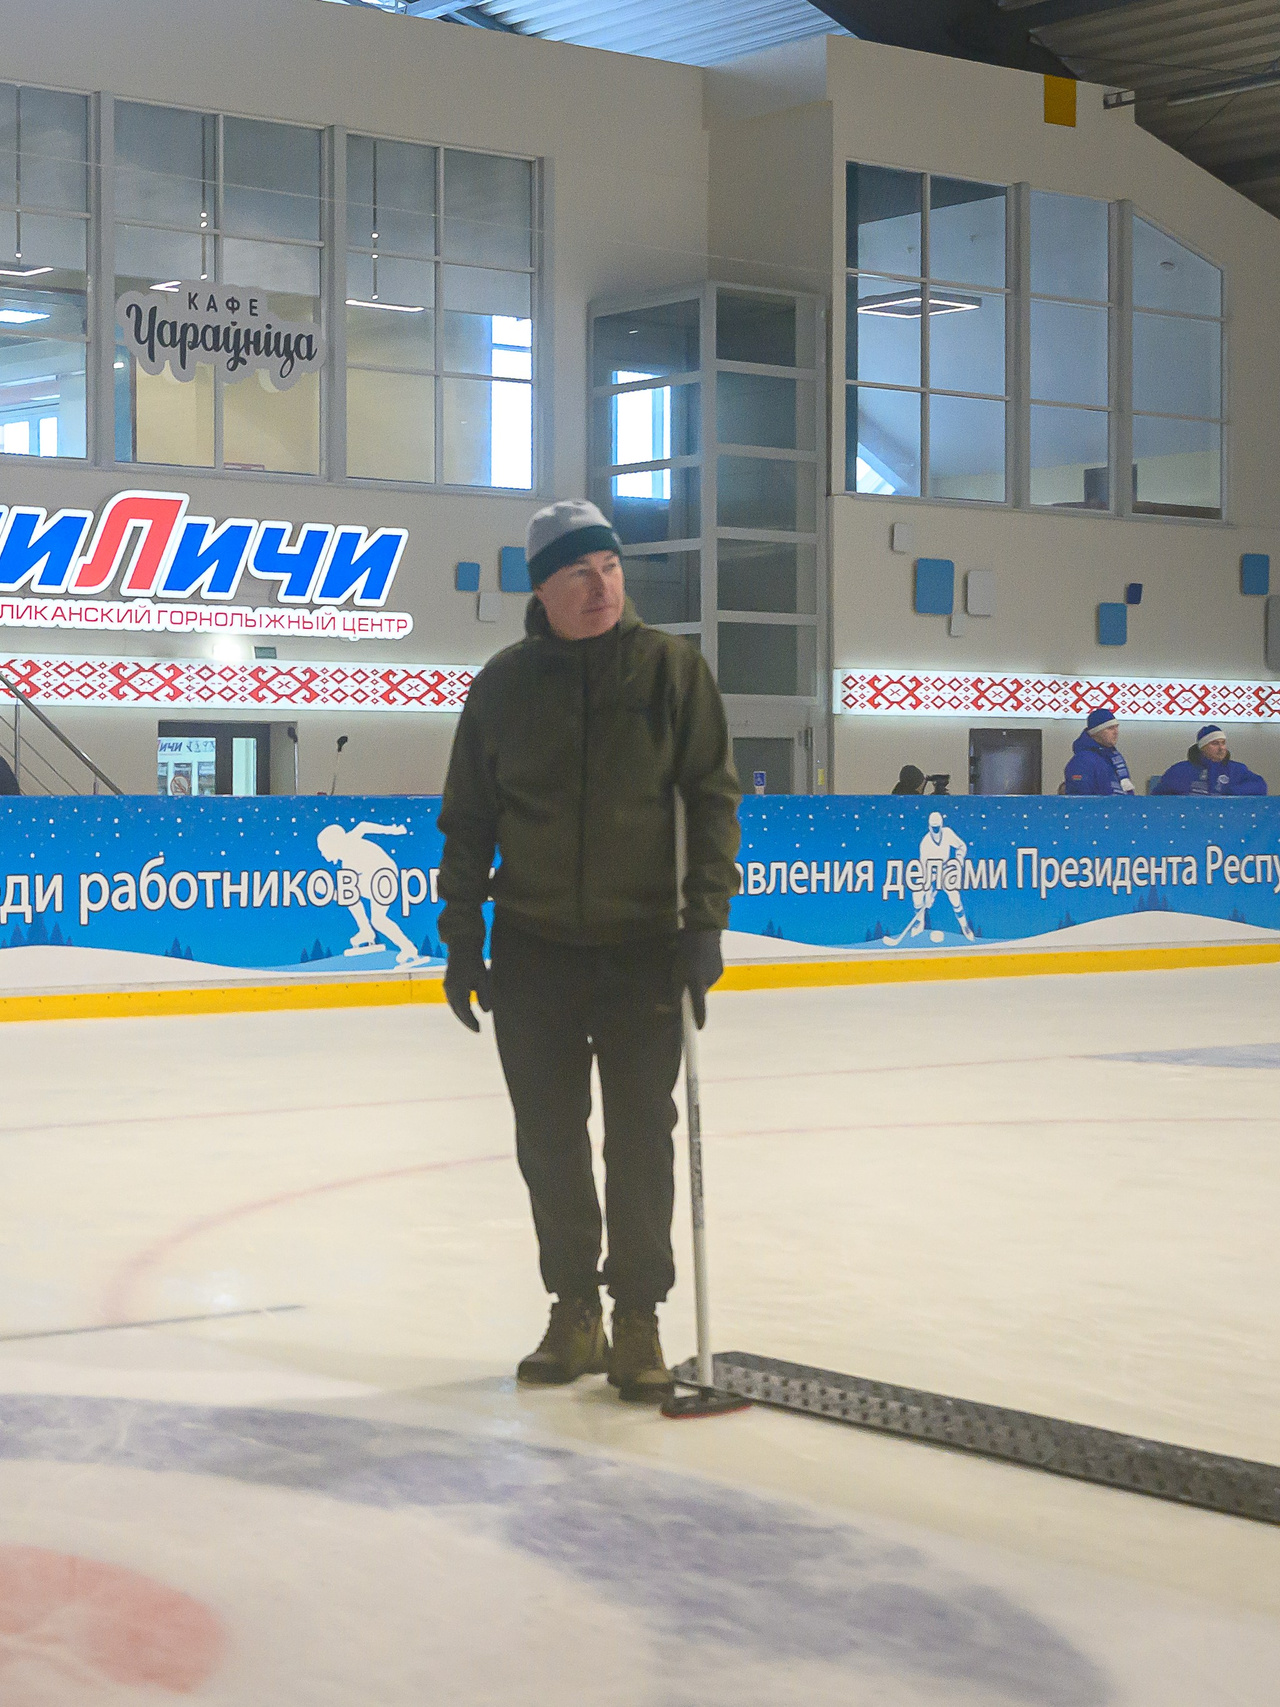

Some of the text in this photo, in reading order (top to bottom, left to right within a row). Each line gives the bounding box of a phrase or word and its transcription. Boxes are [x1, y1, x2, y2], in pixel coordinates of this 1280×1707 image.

[188, 291, 259, 316] КАФЕ
[125, 303, 317, 379] Чараўніца
[157, 605, 336, 634] ГОРНОЛЫЖНЫЙ
[340, 614, 408, 638] ЦЕНТР
[158, 739, 183, 752] ИЧИ
[79, 855, 361, 925] работников
[882, 856, 1007, 900] делами
[1016, 846, 1196, 900] Президента
